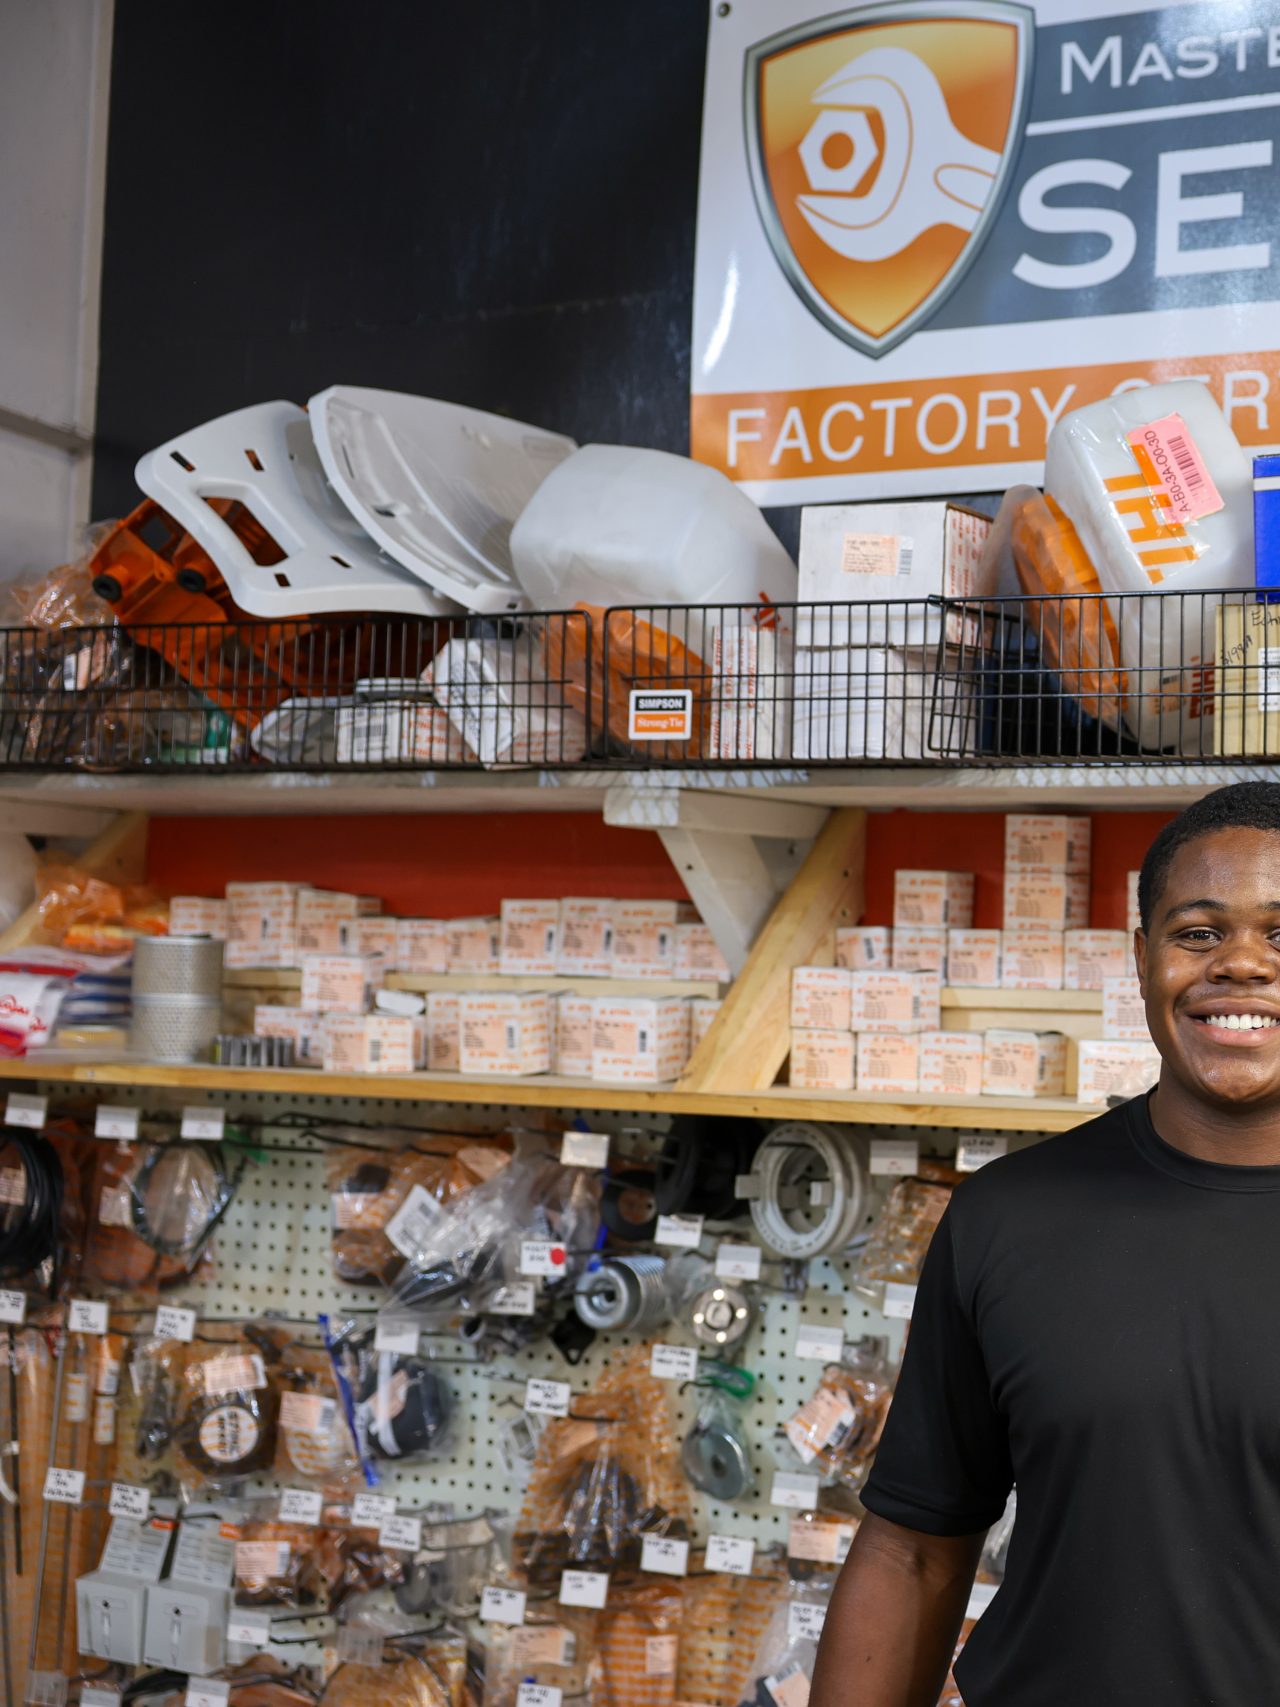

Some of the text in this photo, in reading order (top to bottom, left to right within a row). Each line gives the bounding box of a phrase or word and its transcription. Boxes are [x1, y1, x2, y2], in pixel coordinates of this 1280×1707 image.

[726, 384, 1077, 468] FACTORY
[1103, 444, 1200, 586] IHL
[637, 717, 685, 729] Strong-Tie
[638, 698, 683, 709] SIMPSON
